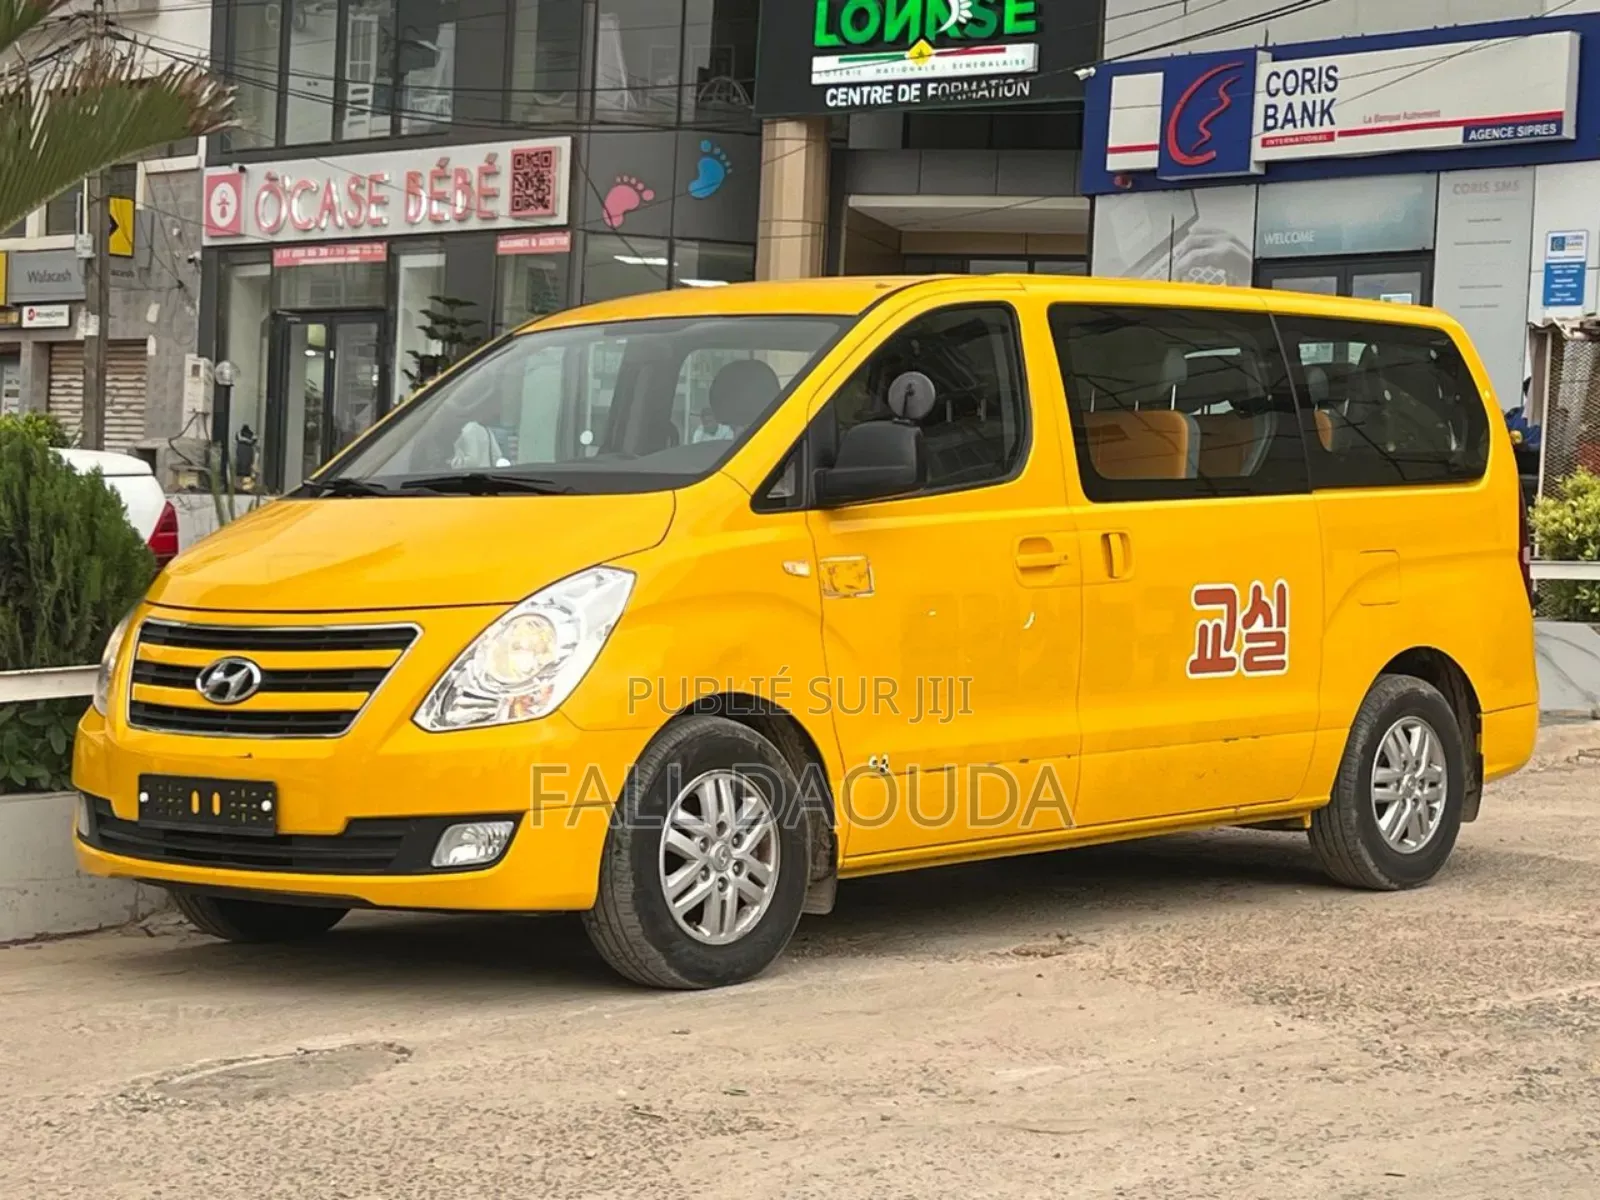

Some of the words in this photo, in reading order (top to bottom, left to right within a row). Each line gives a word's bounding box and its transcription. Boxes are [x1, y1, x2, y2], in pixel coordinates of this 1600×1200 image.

[825, 85, 893, 107] CENTRE
[897, 83, 921, 103] DE
[928, 78, 1031, 100] FORMATION
[1265, 65, 1339, 98] CORIS
[1263, 98, 1337, 133] BANK
[1265, 134, 1329, 146] INTERNATIONAL
[1468, 127, 1515, 141] AGENCE
[1516, 123, 1557, 137] SIPRES
[404, 152, 500, 225] BÉBÉ
[1452, 181, 1490, 196] CORIS
[1492, 179, 1520, 194] SMS
[1263, 229, 1316, 246] WELCOME
[1187, 579, 1288, 678] 교실
